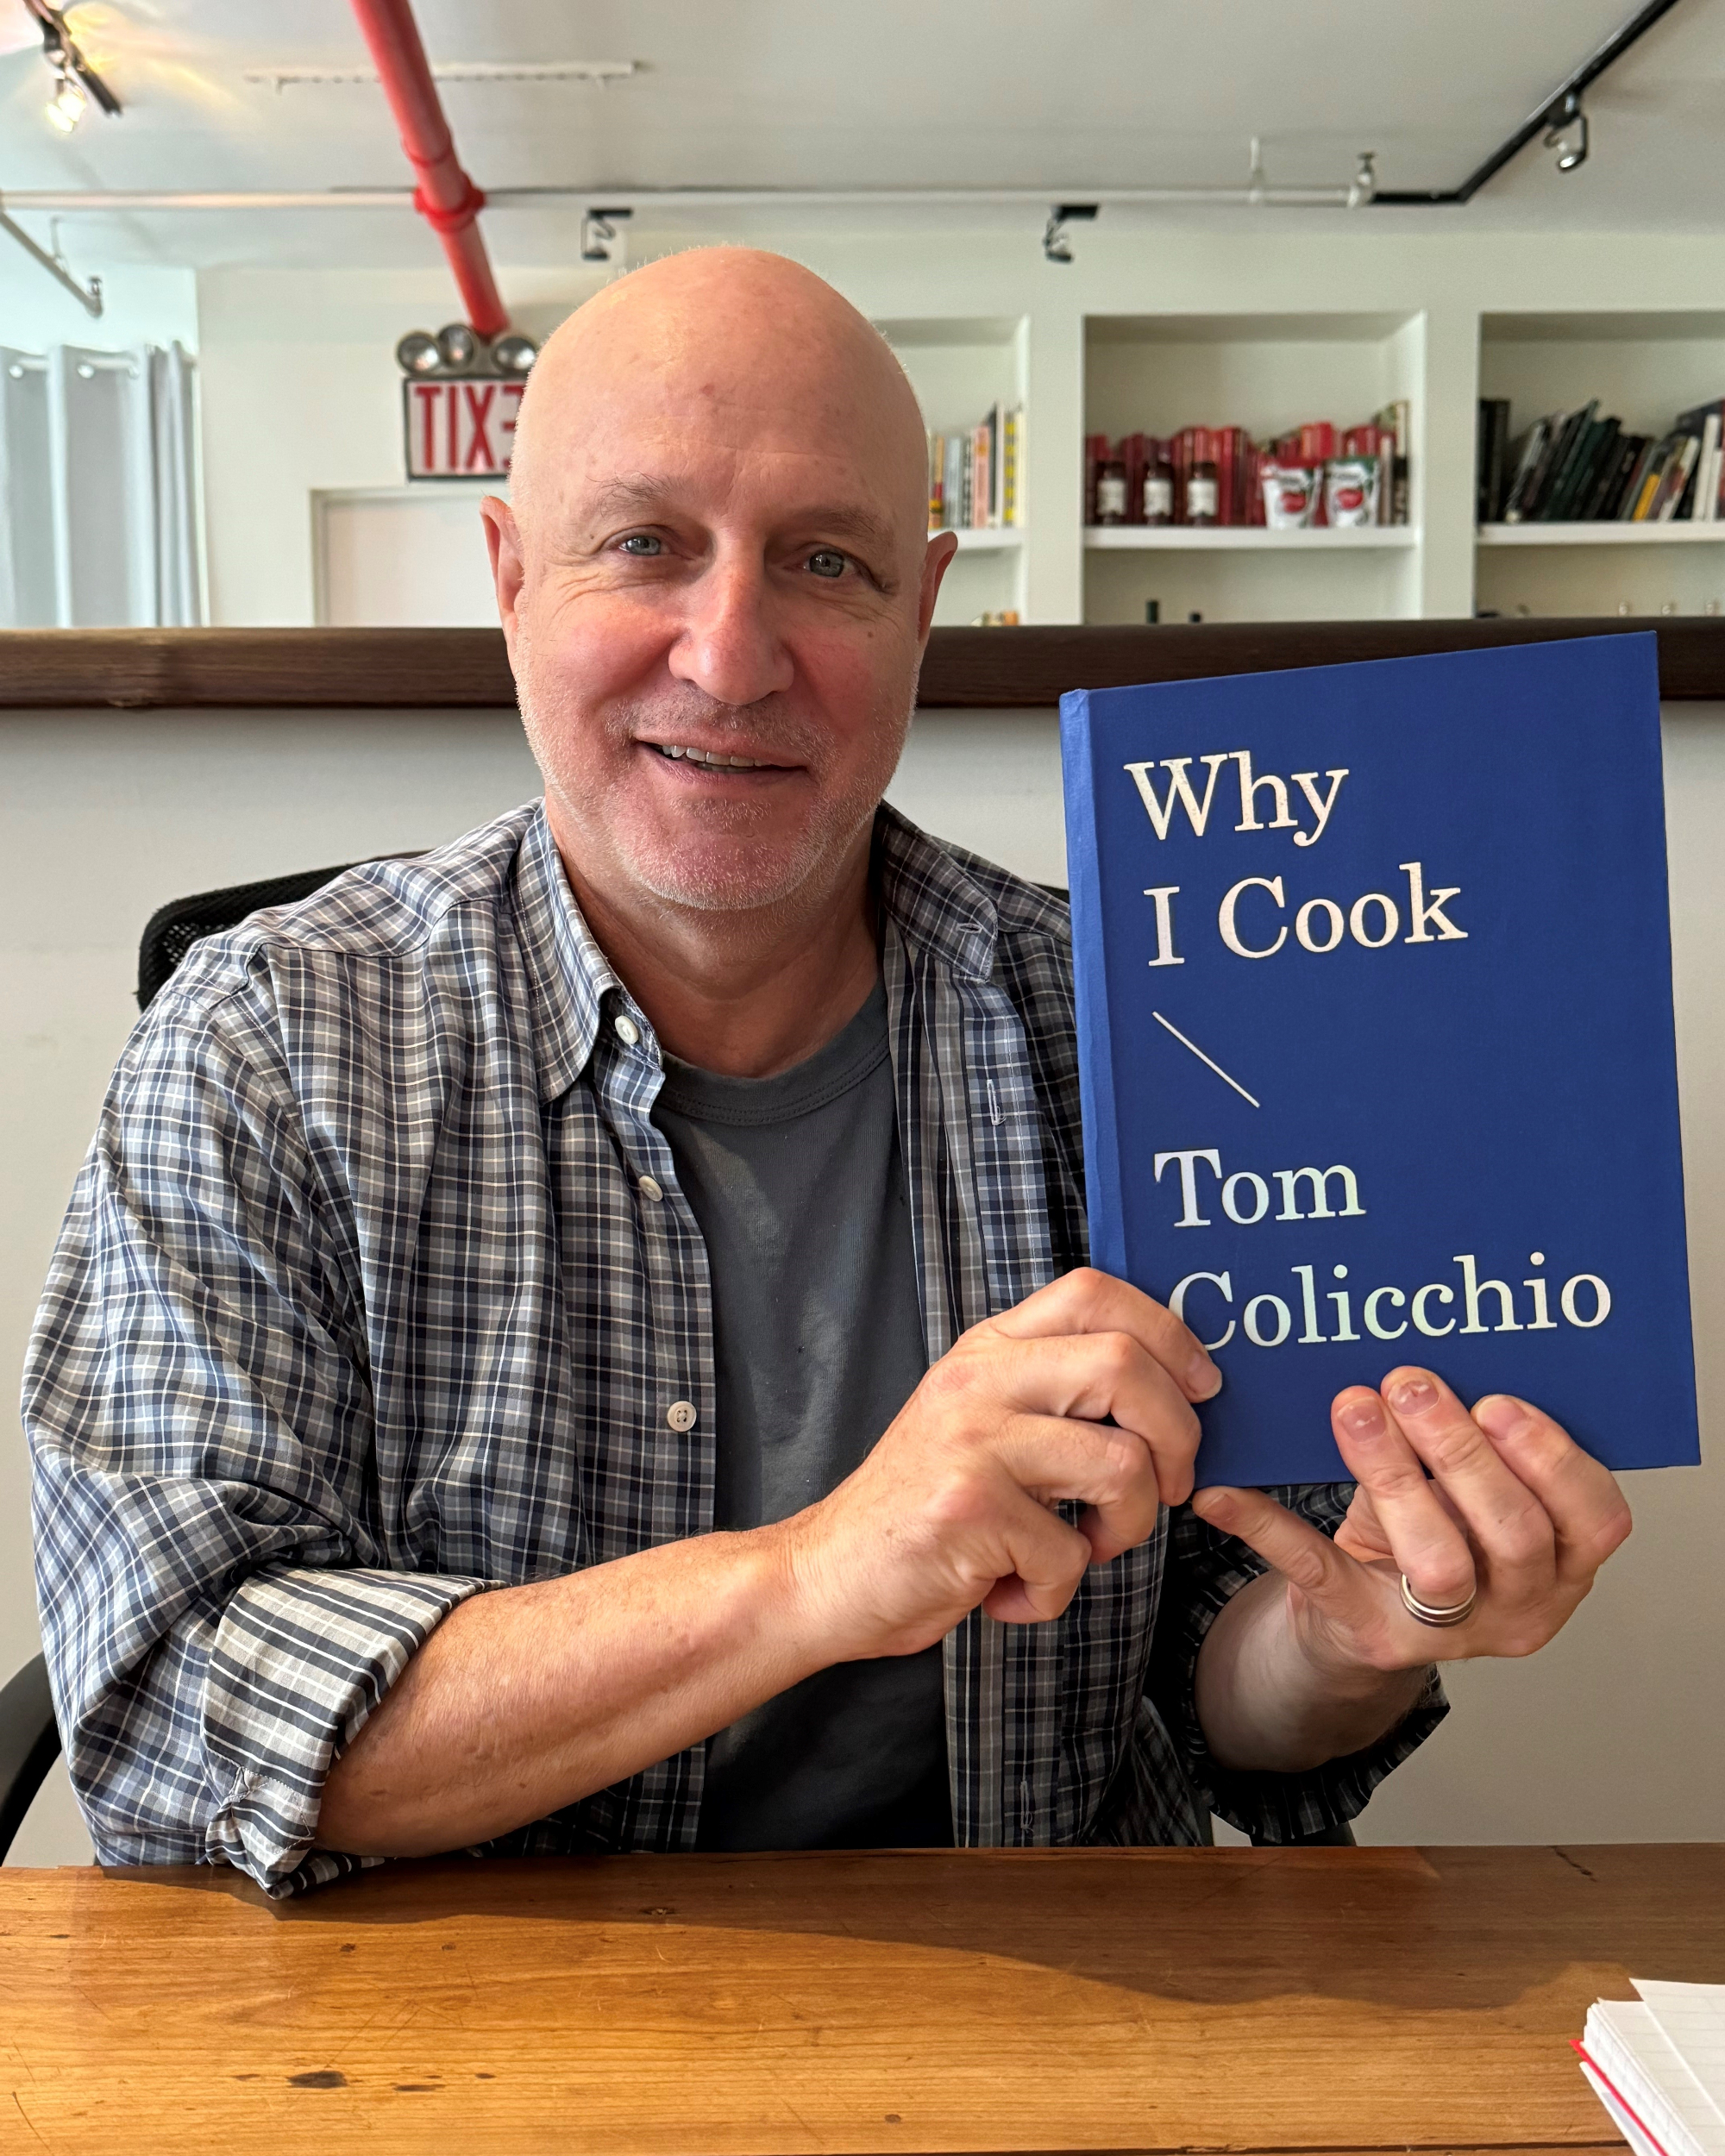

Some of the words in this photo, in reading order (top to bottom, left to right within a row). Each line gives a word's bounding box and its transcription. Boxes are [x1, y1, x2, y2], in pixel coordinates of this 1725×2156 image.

[1123, 749, 1350, 847] Why
[1143, 886, 1185, 967] I
[1218, 862, 1469, 959] Cook
[1154, 1149, 1366, 1228] Tom
[1168, 1251, 1611, 1351] Colicchio
